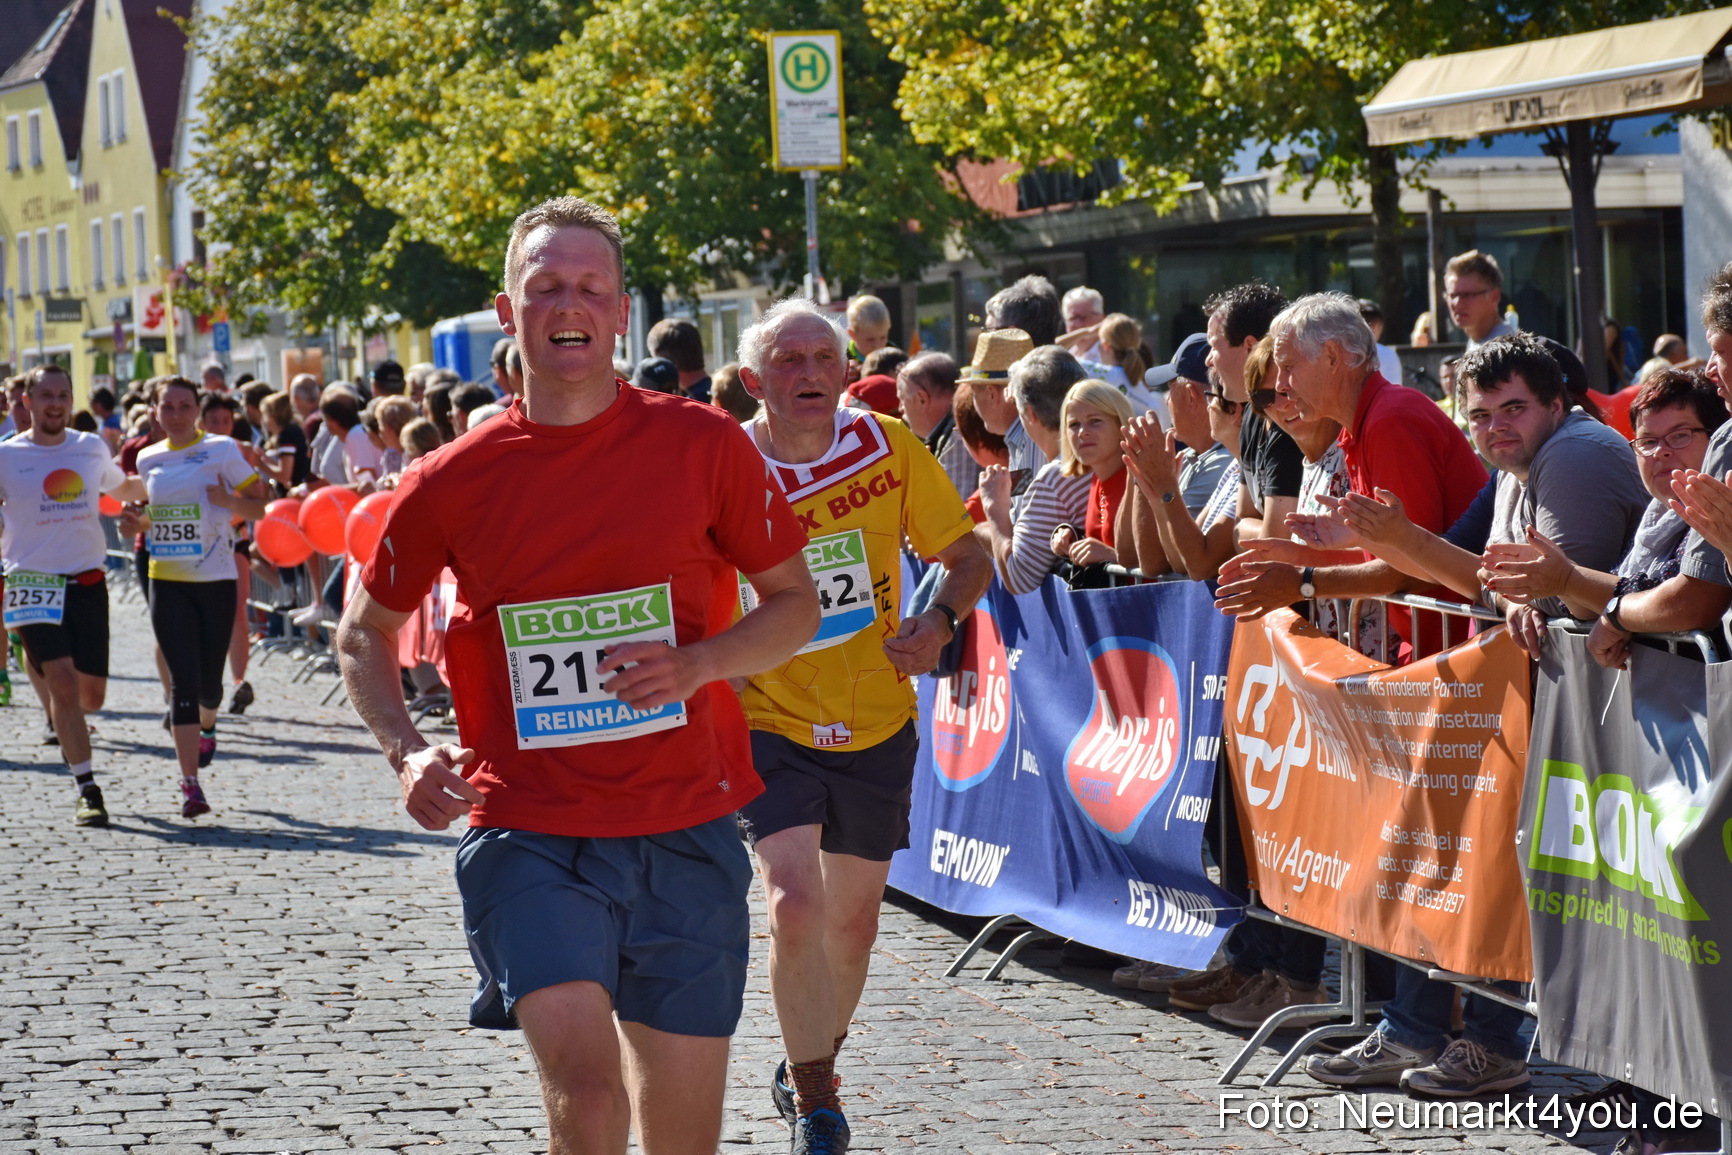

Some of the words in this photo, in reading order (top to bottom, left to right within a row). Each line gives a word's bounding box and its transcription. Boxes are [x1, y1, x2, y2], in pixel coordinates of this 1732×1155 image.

[826, 468, 903, 521] BÖGL
[152, 507, 193, 519] BOCK
[155, 523, 196, 541] 2258
[804, 539, 855, 566] CK
[8, 574, 58, 585] BOCK
[819, 573, 858, 610] 42
[9, 589, 57, 608] 2257
[516, 598, 652, 638] BOCK
[1386, 675, 1432, 697] moderner
[1433, 676, 1485, 699] Partner
[1074, 689, 1175, 797] hervis
[1461, 770, 1498, 798] angeht.
[1393, 825, 1411, 845] Sie
[1377, 852, 1400, 872] web:
[1126, 878, 1159, 929] GET
[1376, 879, 1394, 900] tel:
[1416, 887, 1446, 911] 8833
[1443, 890, 1466, 915] 897
[1526, 877, 1613, 926] inspired
[1617, 897, 1629, 940] by
